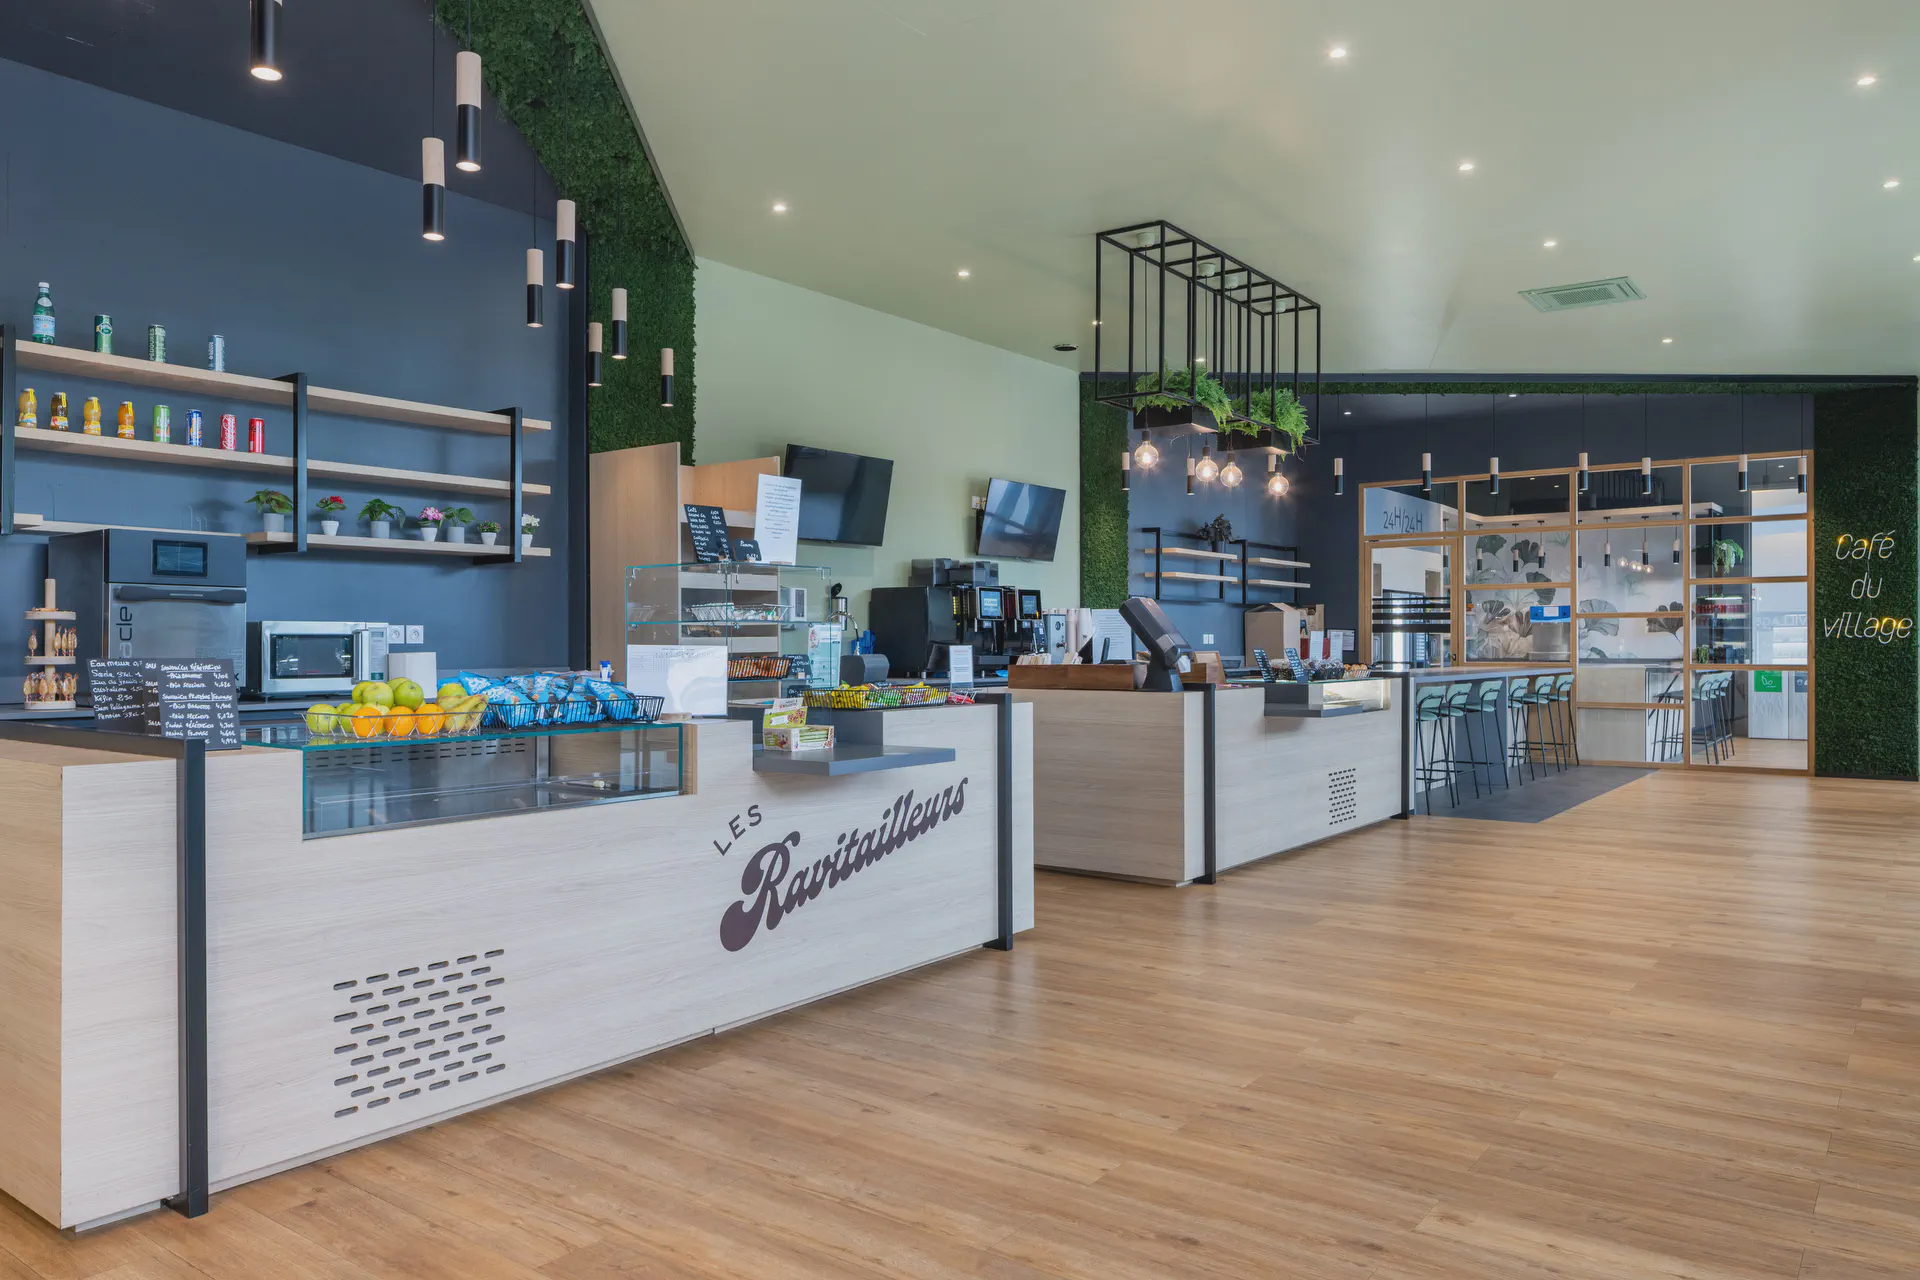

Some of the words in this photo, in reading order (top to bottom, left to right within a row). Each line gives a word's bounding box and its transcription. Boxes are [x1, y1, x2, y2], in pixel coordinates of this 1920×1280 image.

[1383, 507, 1423, 533] 24H/24H
[1836, 530, 1896, 560] Café
[1851, 572, 1882, 599] du
[1824, 612, 1913, 644] village
[713, 804, 762, 856] LES
[720, 777, 968, 951] Ravitailleurs
